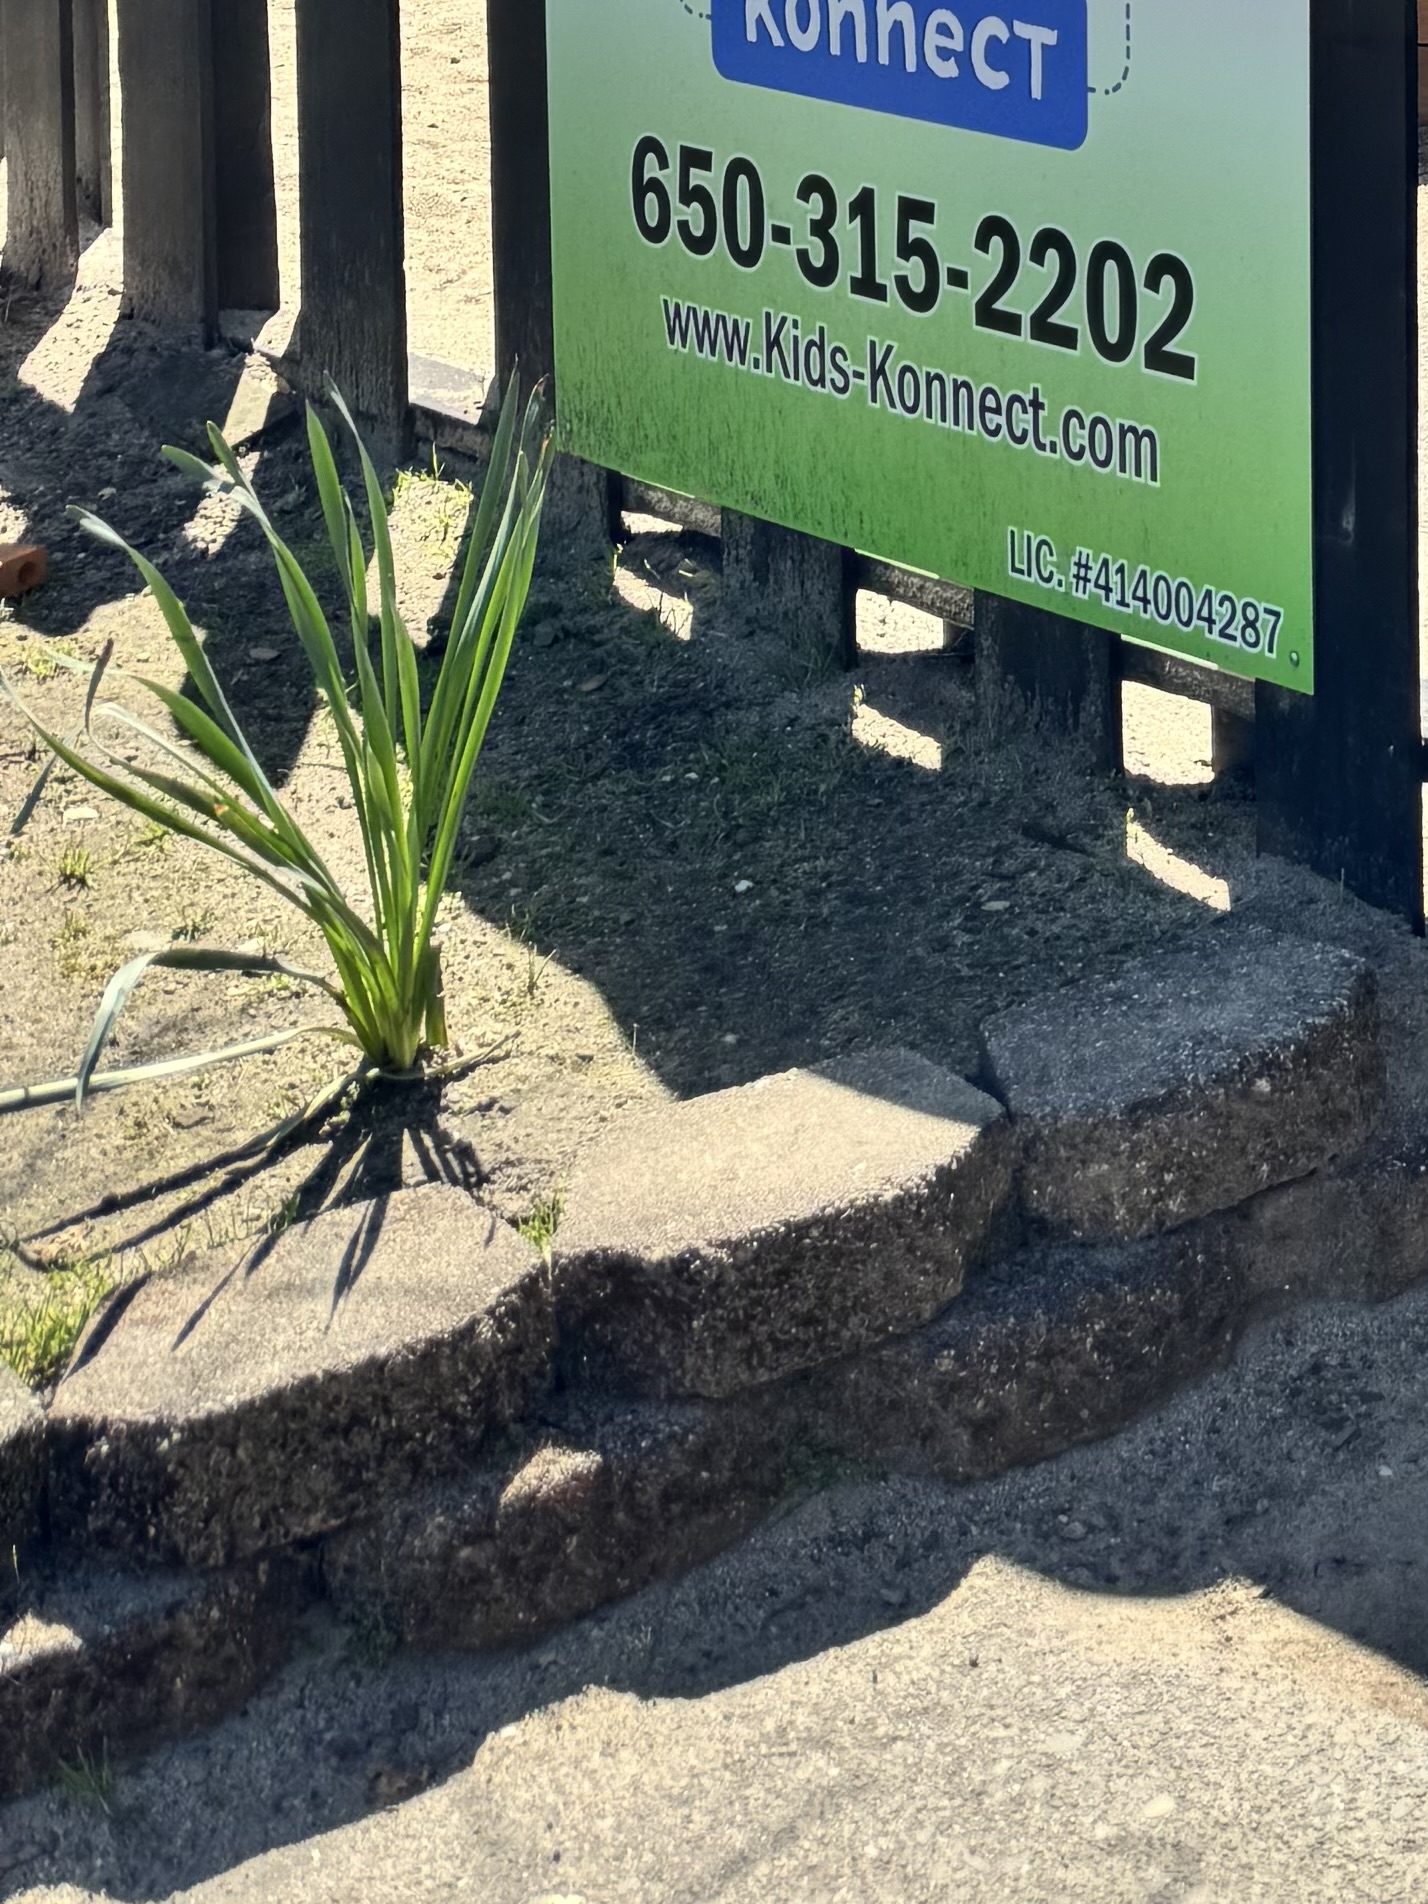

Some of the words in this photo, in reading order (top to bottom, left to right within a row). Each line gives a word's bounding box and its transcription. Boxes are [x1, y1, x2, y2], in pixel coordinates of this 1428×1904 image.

[630, 135, 1197, 381] 650-315-2202
[662, 297, 1160, 483] www.Kids-Konnect.com
[1007, 528, 1064, 590] LIC.
[1071, 550, 1283, 656] #414004287
